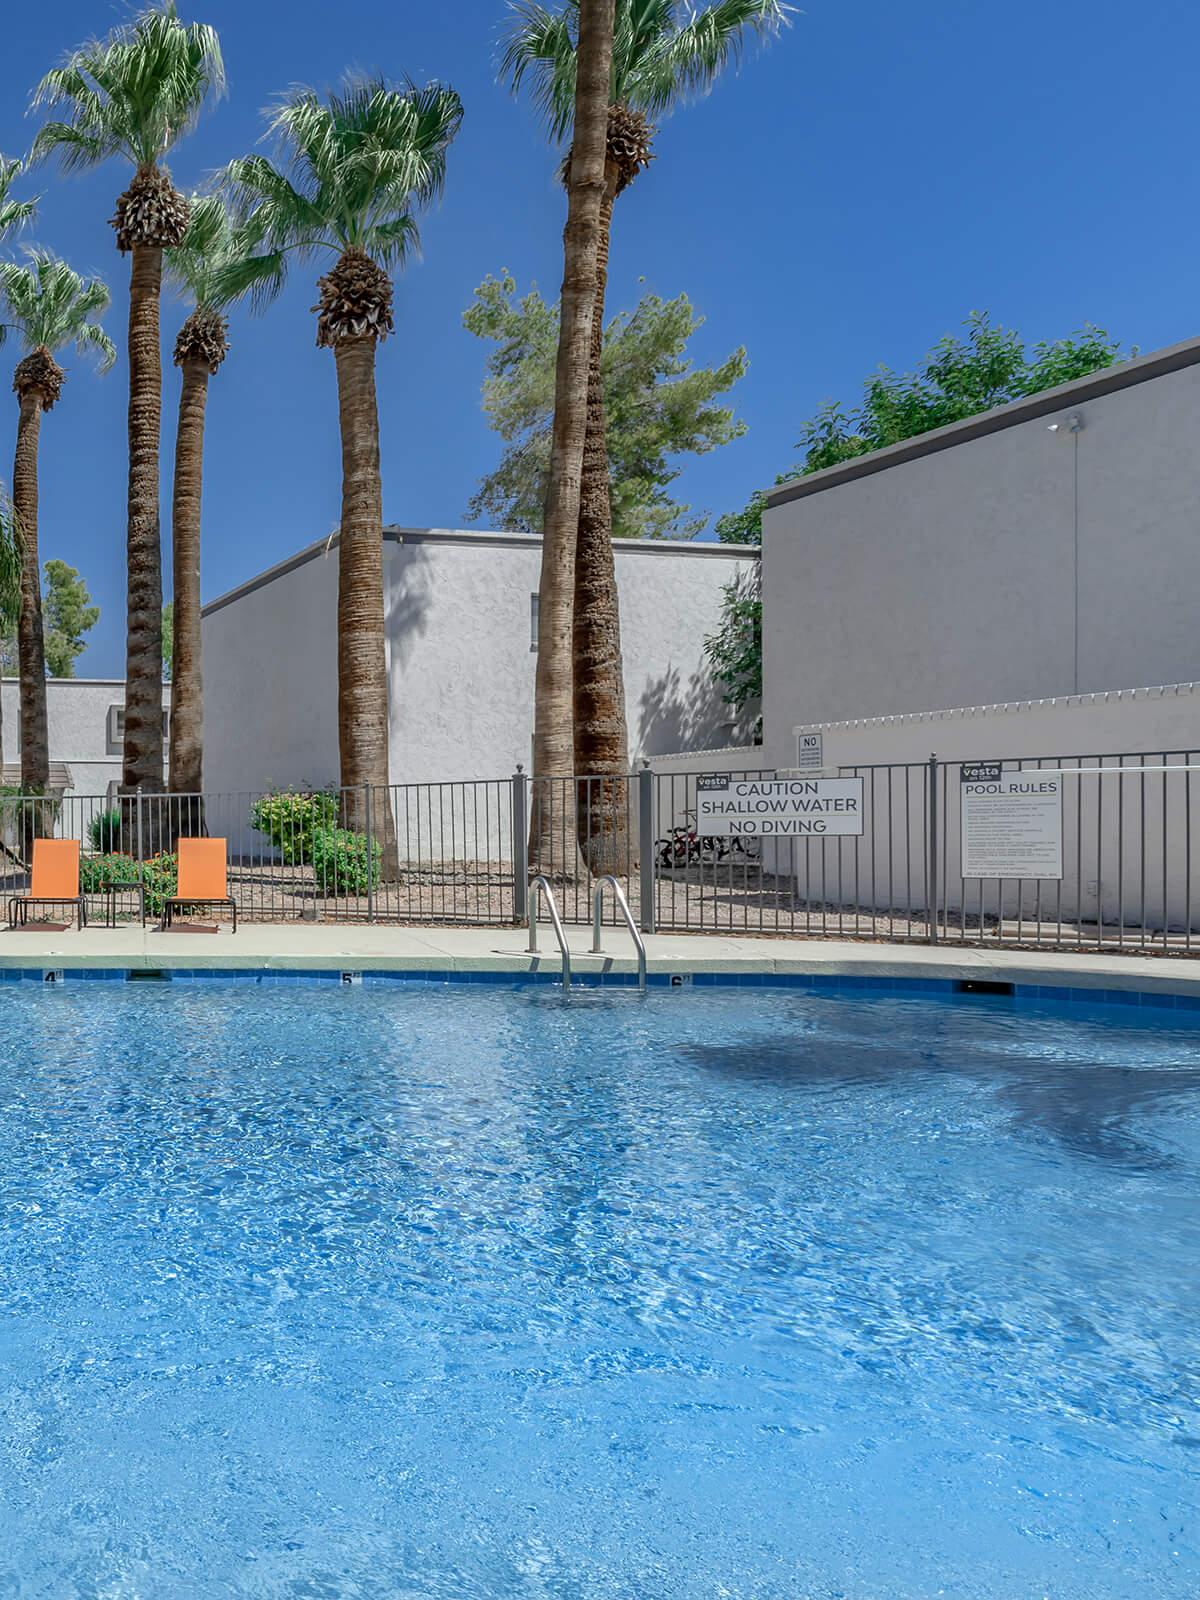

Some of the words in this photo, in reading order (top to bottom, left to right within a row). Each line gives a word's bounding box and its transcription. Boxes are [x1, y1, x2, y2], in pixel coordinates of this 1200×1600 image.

[804, 737, 816, 746] NO
[736, 782, 818, 797] CAUTION
[966, 784, 1006, 794] POOL
[1009, 782, 1057, 793] RULES
[702, 800, 788, 814] SHALLOW
[793, 798, 858, 812] WATER
[730, 821, 756, 833] NO
[762, 820, 827, 833] DIVING
[45, 971, 56, 982] 4
[342, 972, 352, 984] 5
